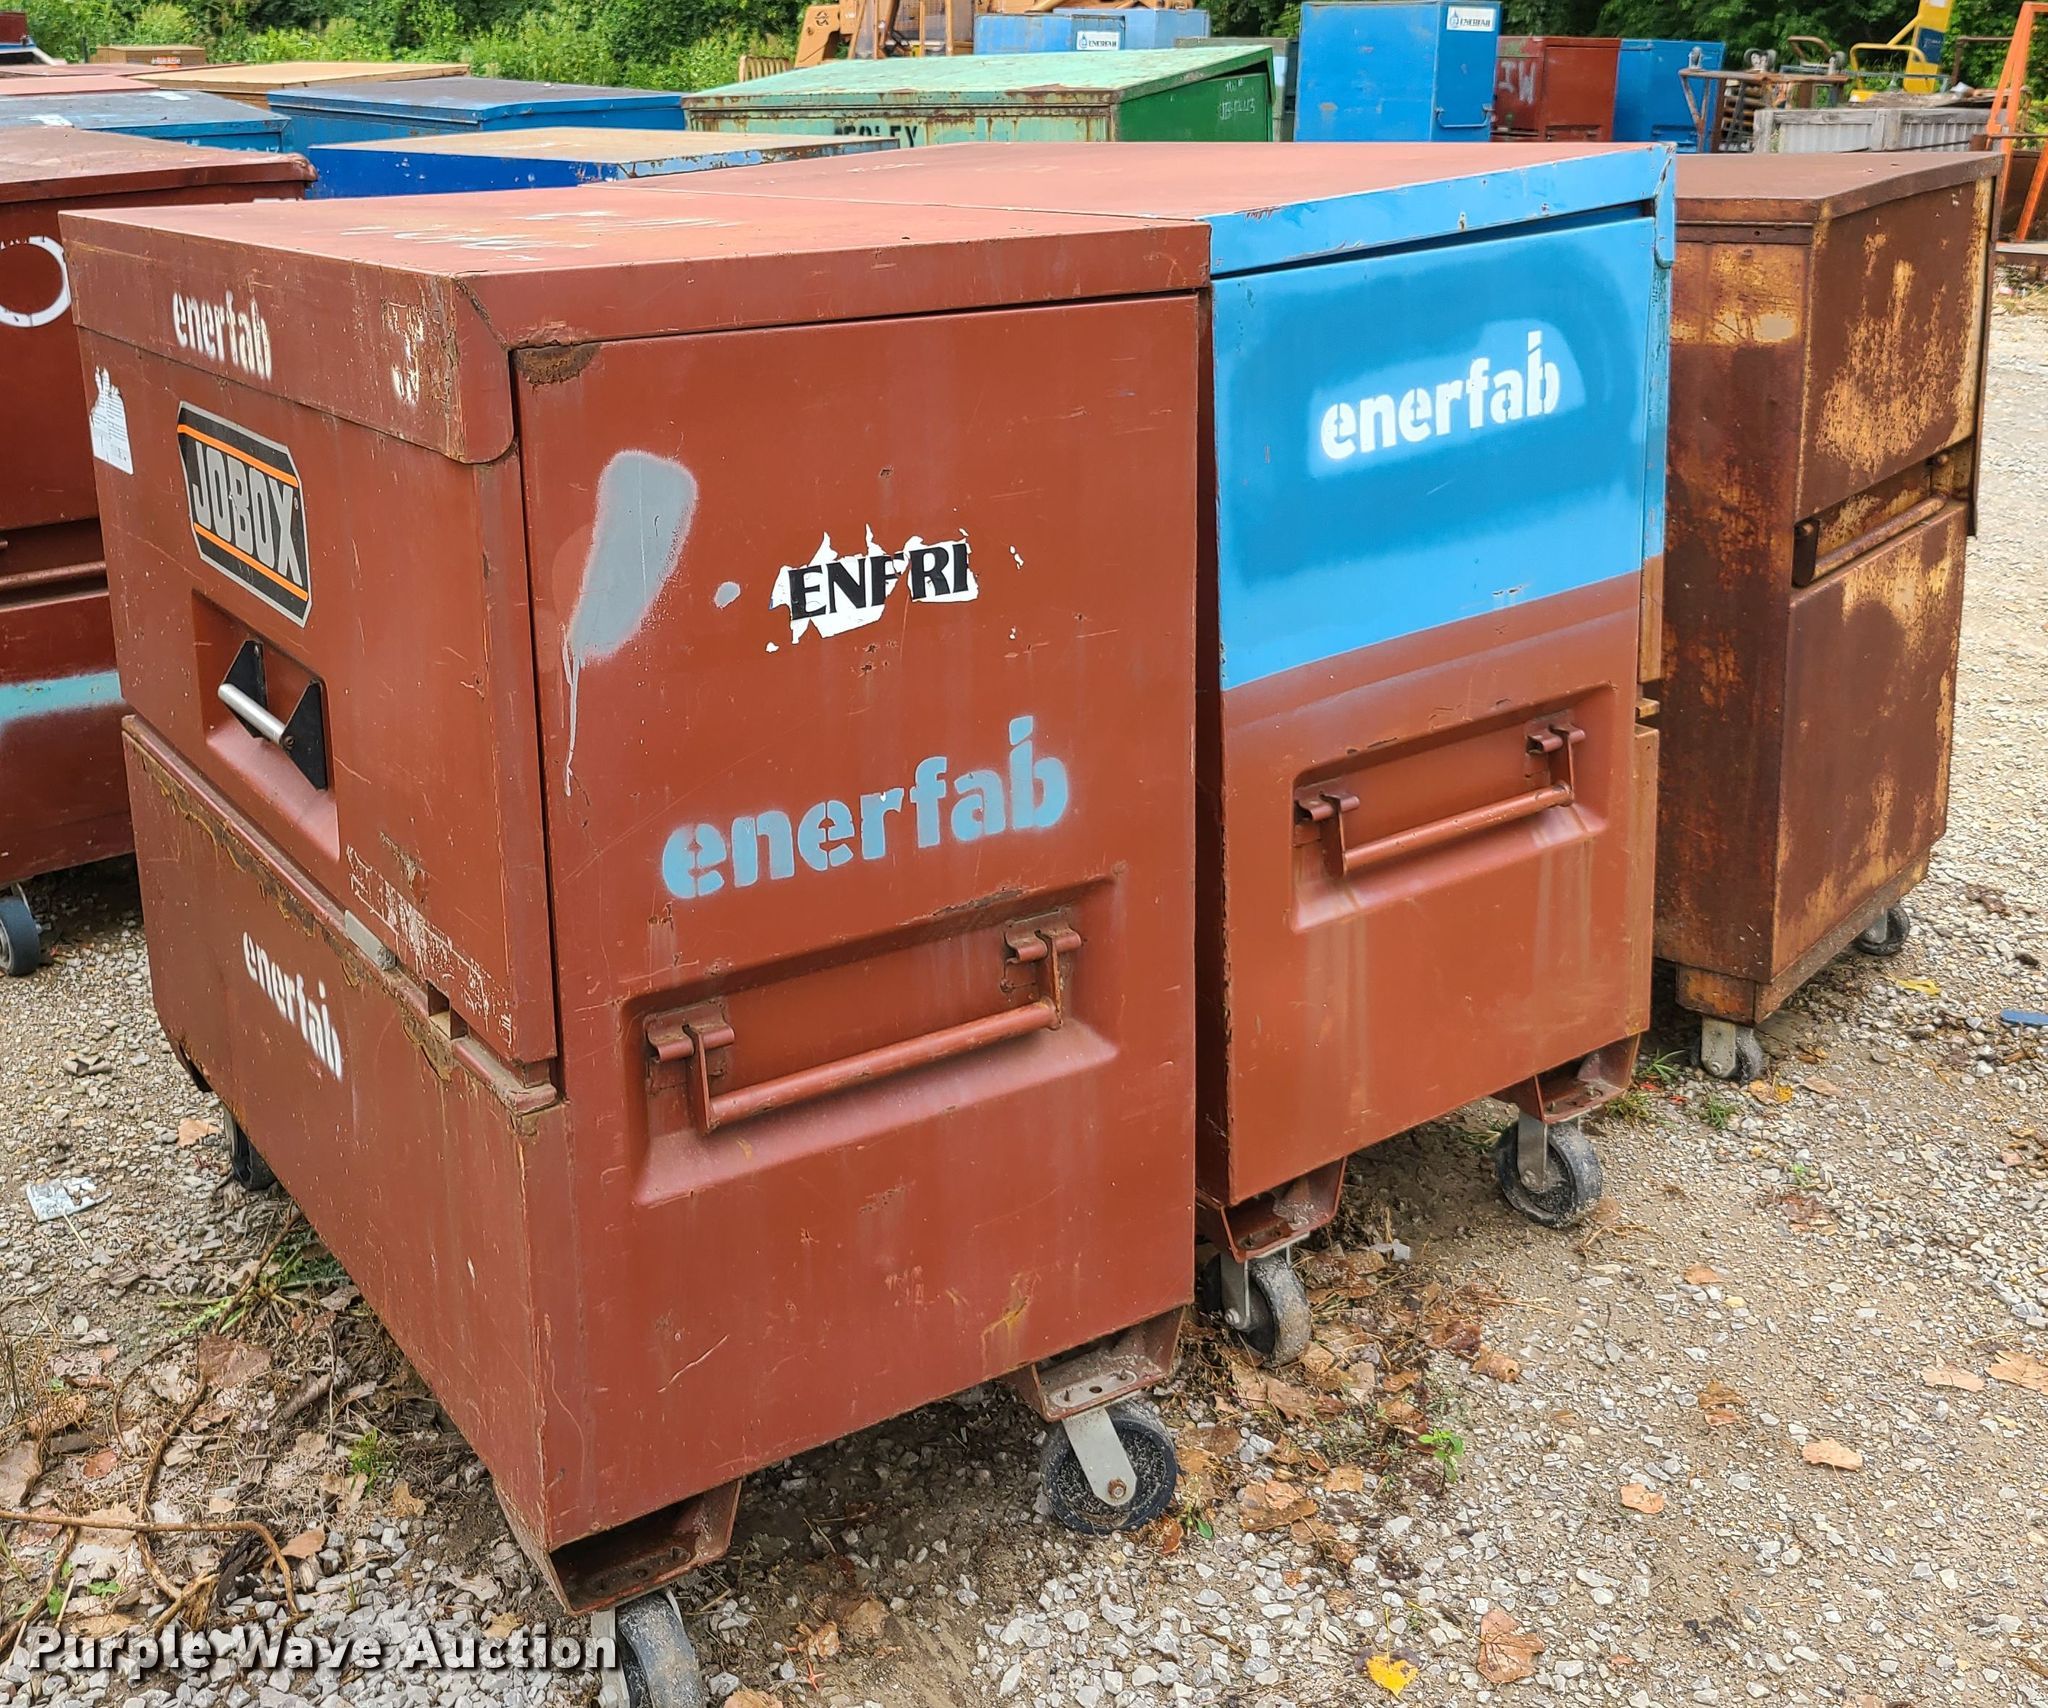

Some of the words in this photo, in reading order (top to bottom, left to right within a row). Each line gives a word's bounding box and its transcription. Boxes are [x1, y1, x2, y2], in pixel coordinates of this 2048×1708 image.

[1320, 330, 1560, 460] enerfab
[192, 441, 303, 587] JOBOX
[660, 714, 1069, 899] enerfab
